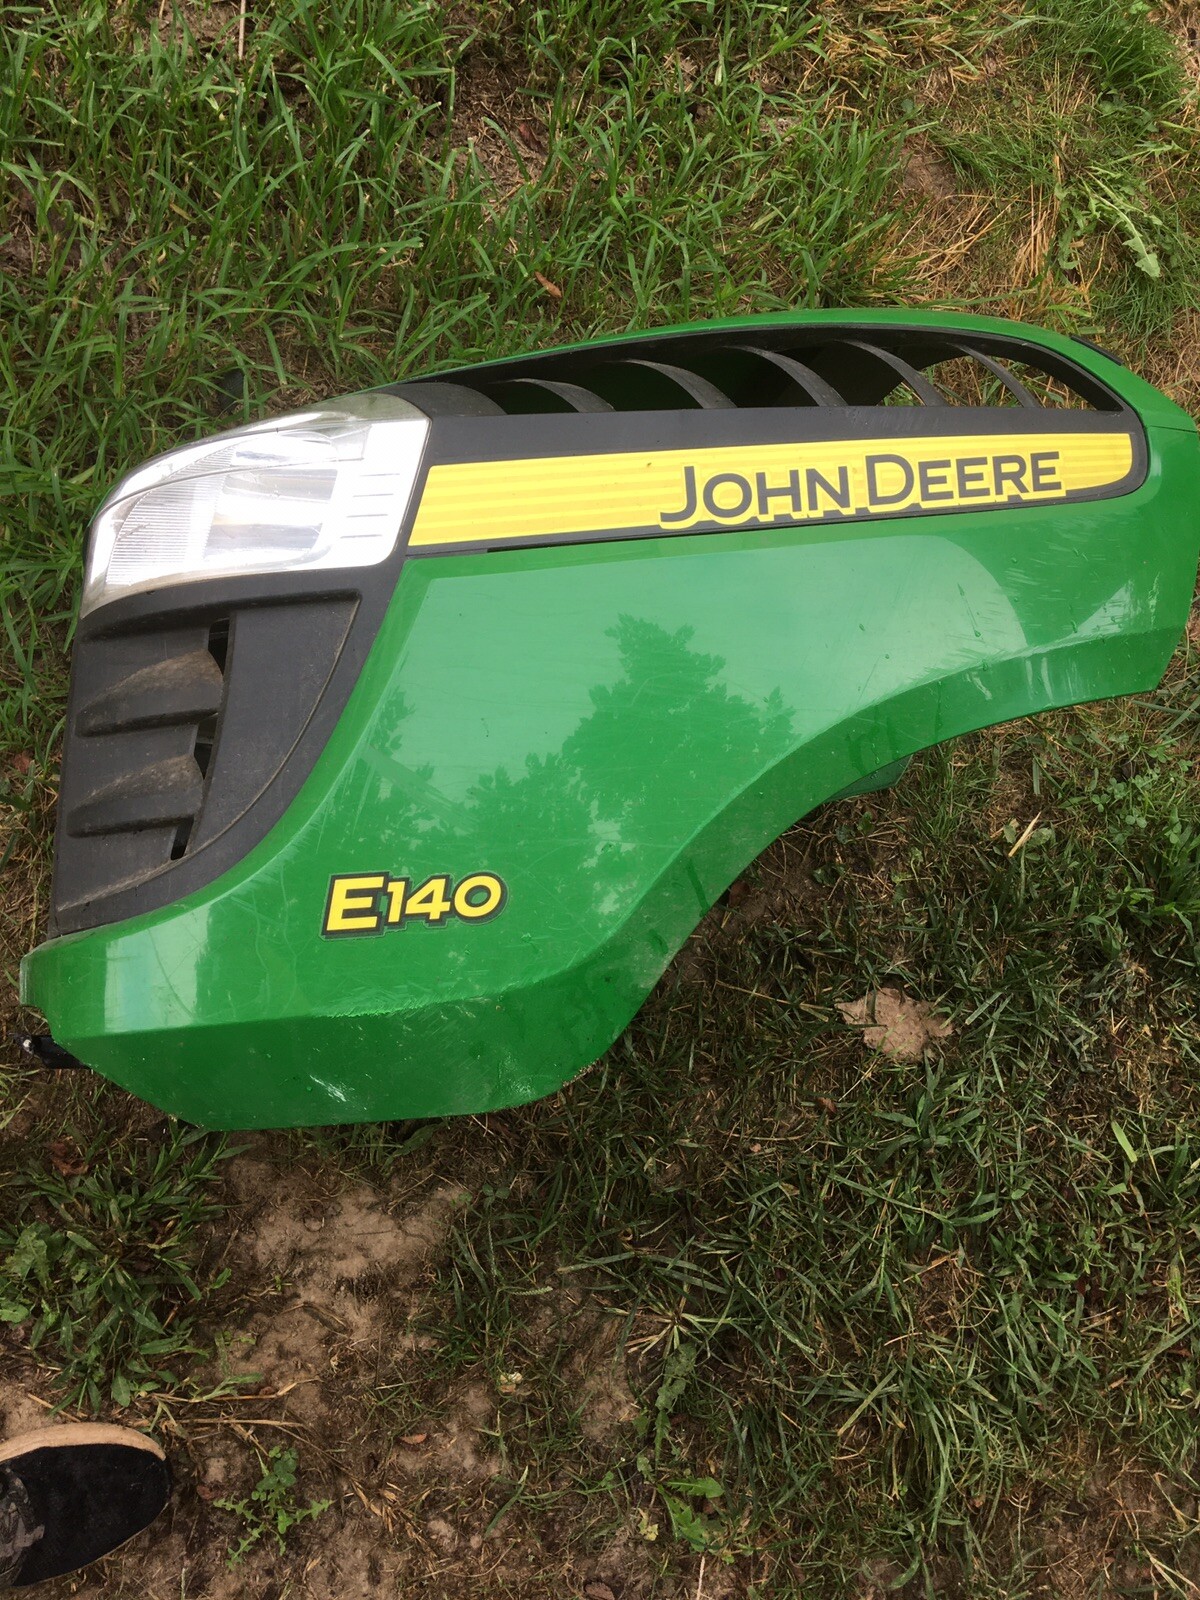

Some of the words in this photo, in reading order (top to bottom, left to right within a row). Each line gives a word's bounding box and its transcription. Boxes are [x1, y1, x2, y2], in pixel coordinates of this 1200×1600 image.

[659, 465, 851, 523] JOHN
[864, 451, 1062, 502] DEERE
[324, 873, 503, 932] E140
